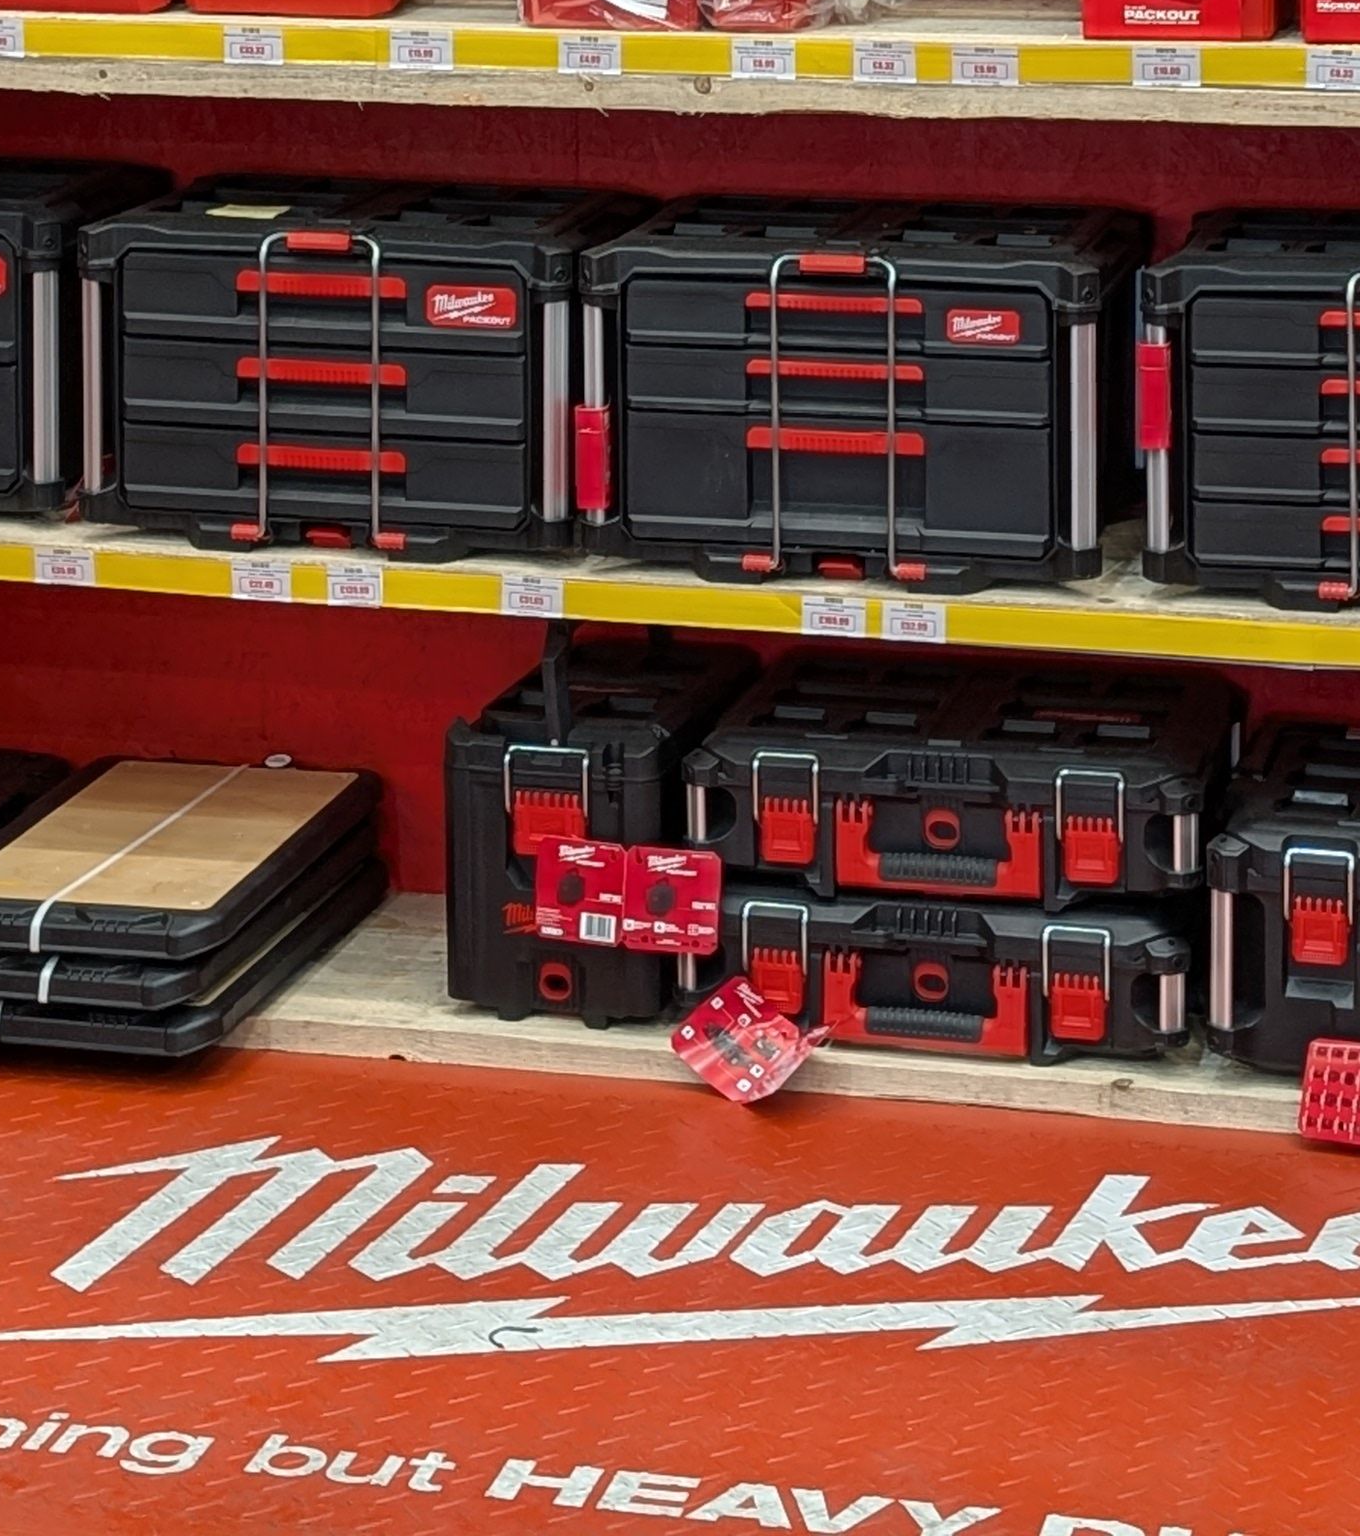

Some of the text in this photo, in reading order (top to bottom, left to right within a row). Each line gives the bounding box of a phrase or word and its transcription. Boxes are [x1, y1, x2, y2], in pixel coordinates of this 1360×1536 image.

[1124, 9, 1200, 21] PACKOUT
[431, 291, 495, 314] Milwaukee
[462, 315, 512, 326] PACKOUT
[951, 312, 1003, 332] Milwaukee
[975, 332, 1016, 342] PACKOUT
[242, 1433, 457, 1493] but
[483, 1458, 1002, 1536] HEAVY
